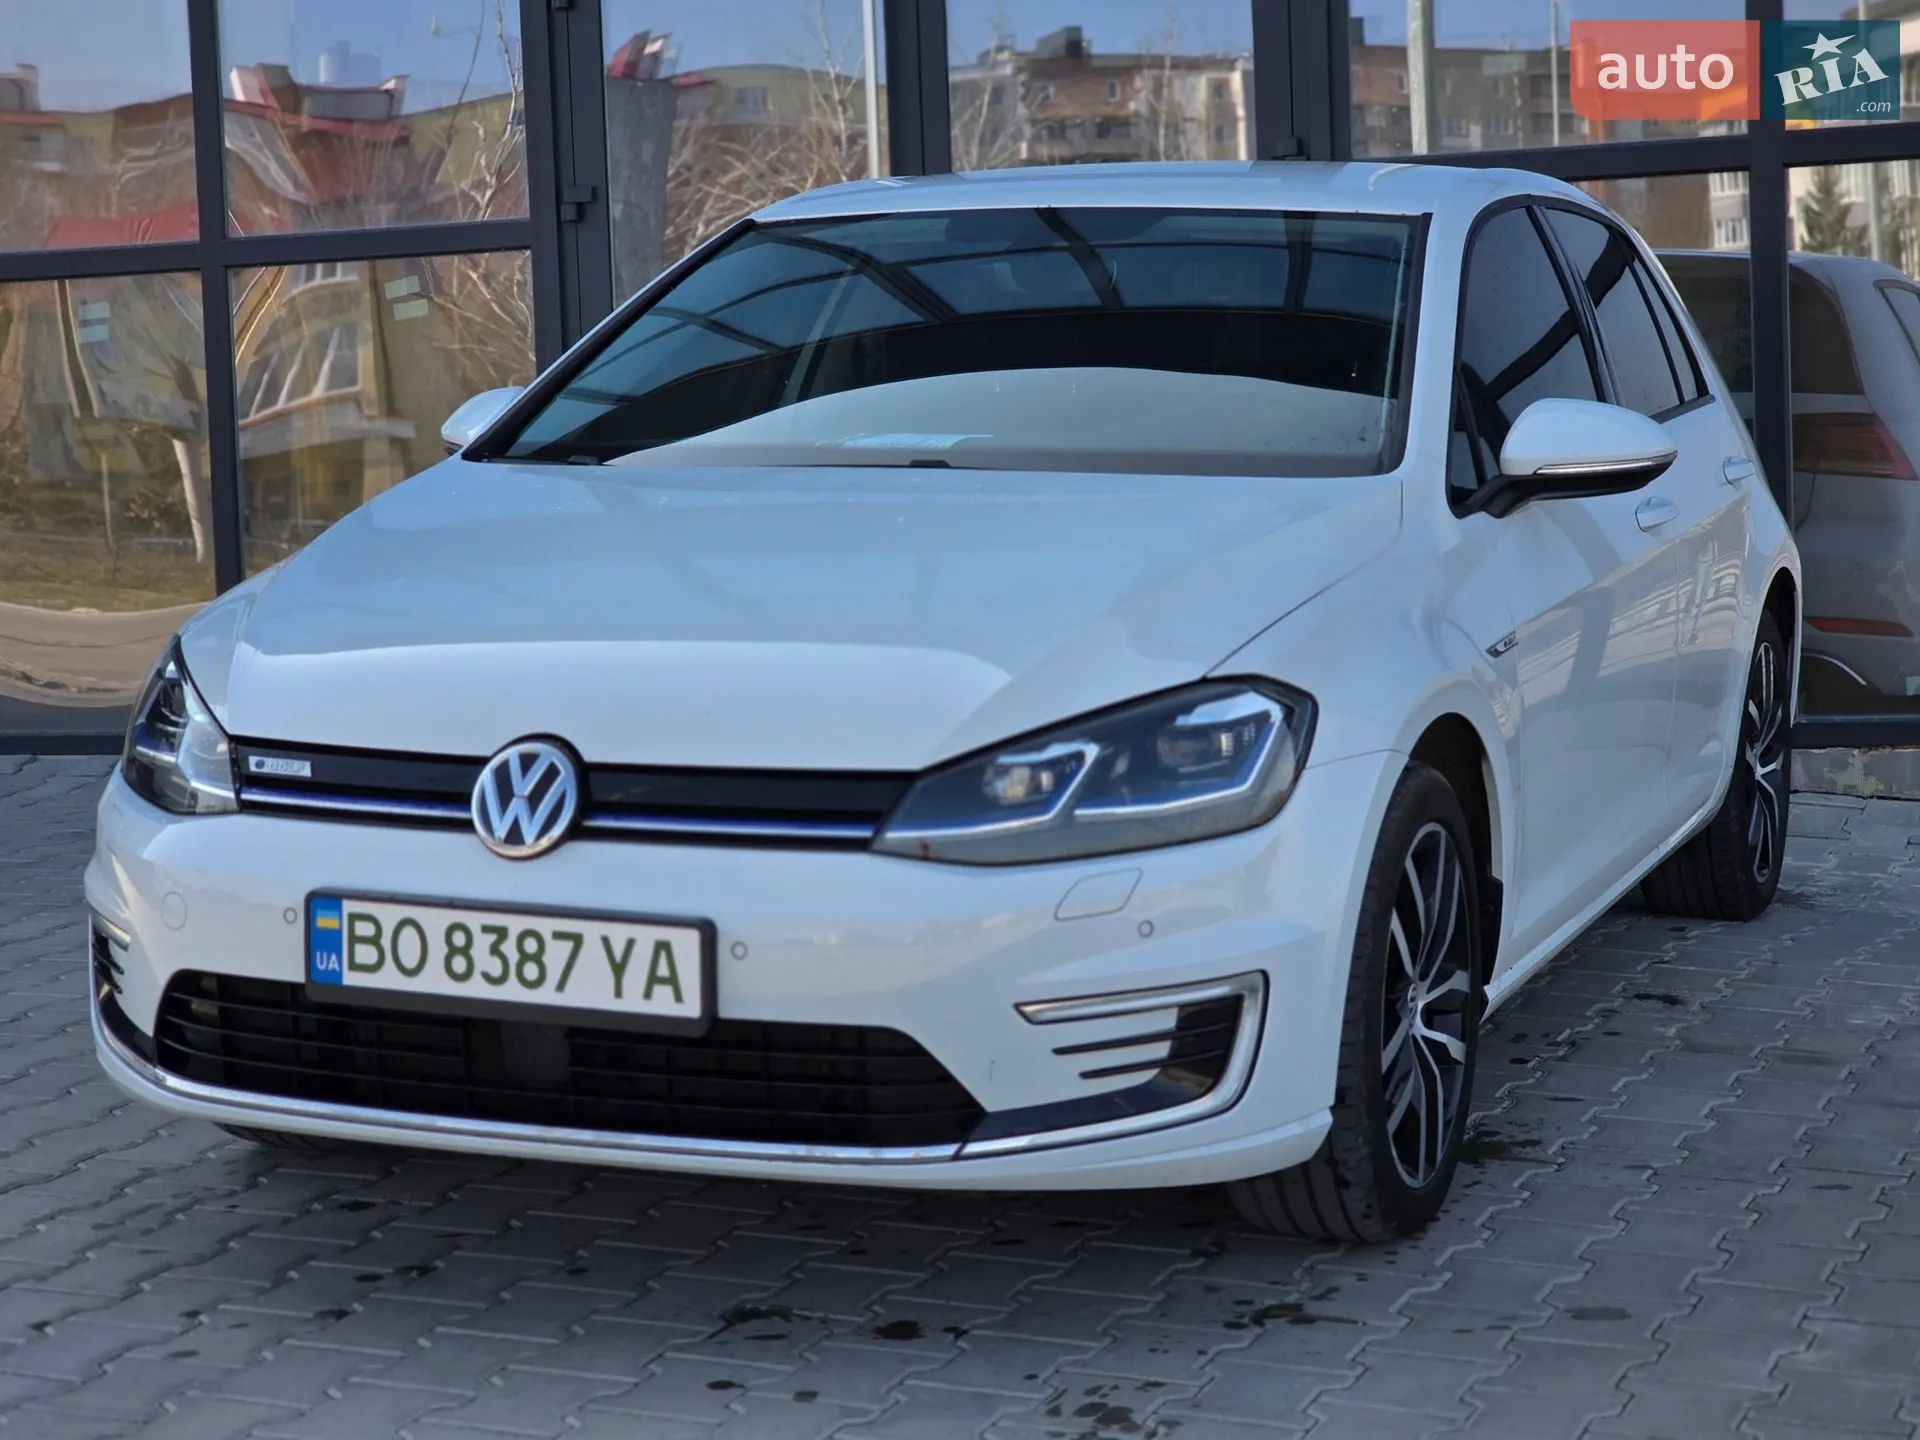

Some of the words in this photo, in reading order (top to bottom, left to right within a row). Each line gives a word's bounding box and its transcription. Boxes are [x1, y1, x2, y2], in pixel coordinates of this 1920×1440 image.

[315, 951, 341, 973] UA
[346, 911, 429, 978] BO
[443, 921, 584, 994] 8387
[599, 934, 684, 1004] YA
